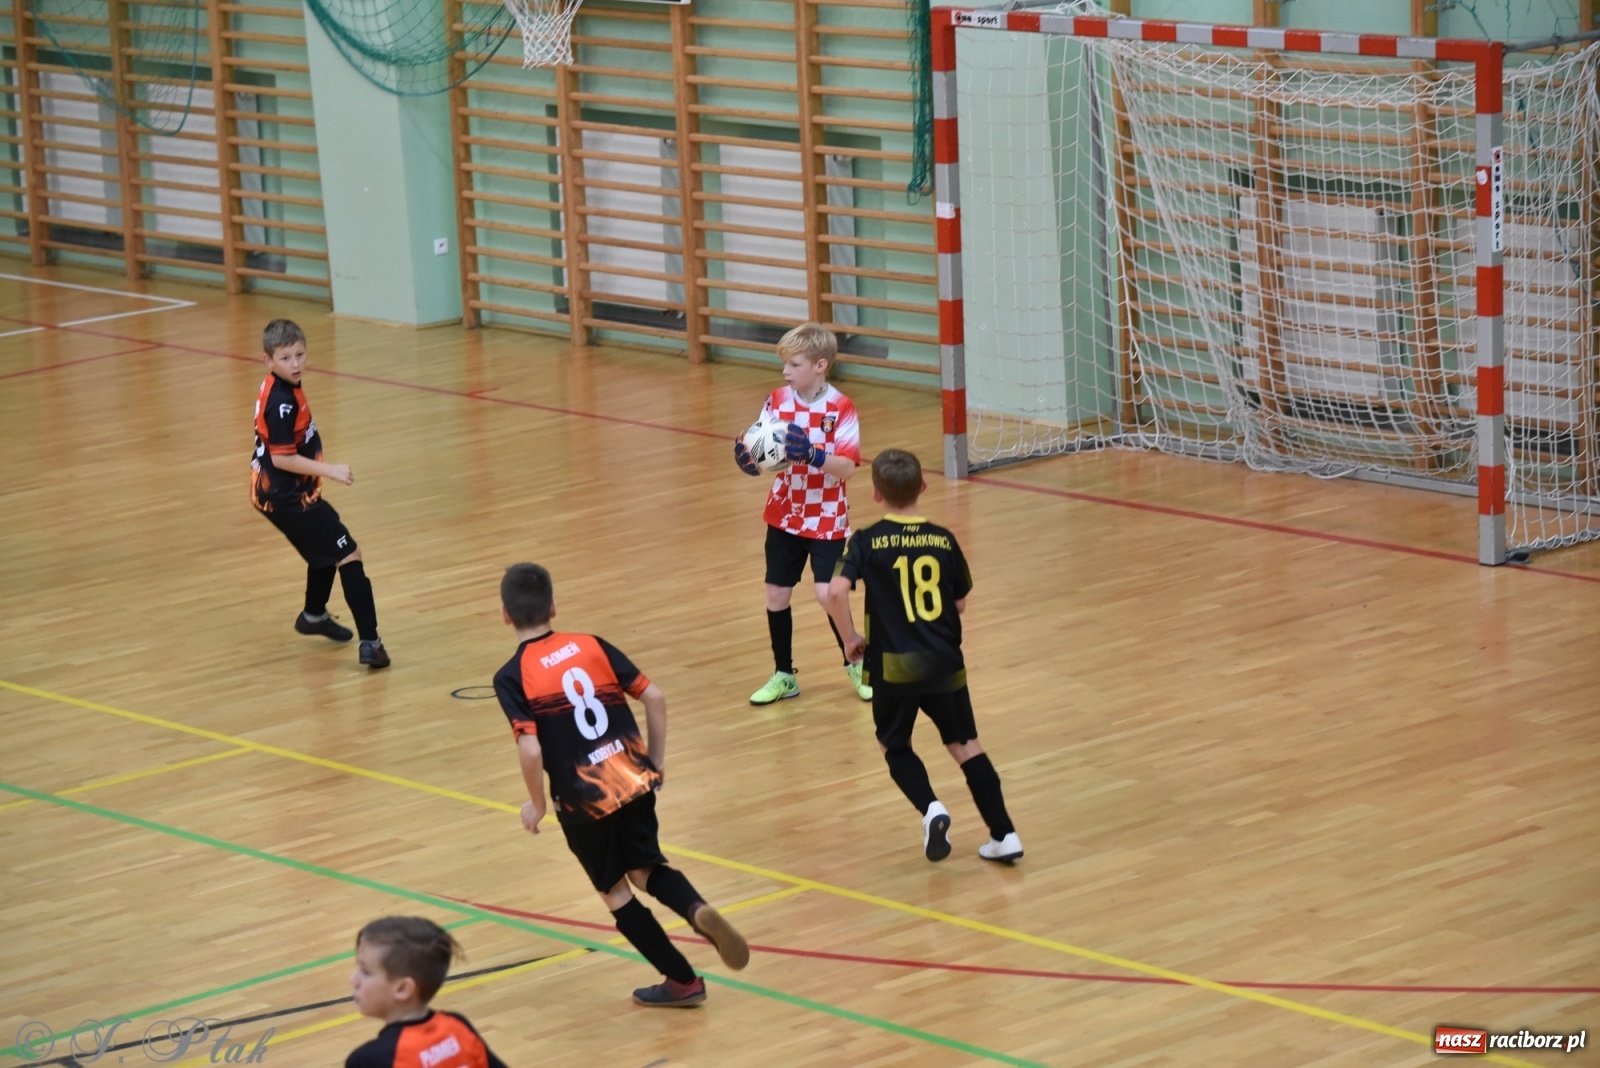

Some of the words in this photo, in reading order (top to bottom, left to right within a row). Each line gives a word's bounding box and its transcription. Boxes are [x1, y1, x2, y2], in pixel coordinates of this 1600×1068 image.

[872, 535, 889, 549] LKS
[890, 534, 899, 546] 07
[892, 554, 942, 623] 18
[561, 666, 609, 740] 8
